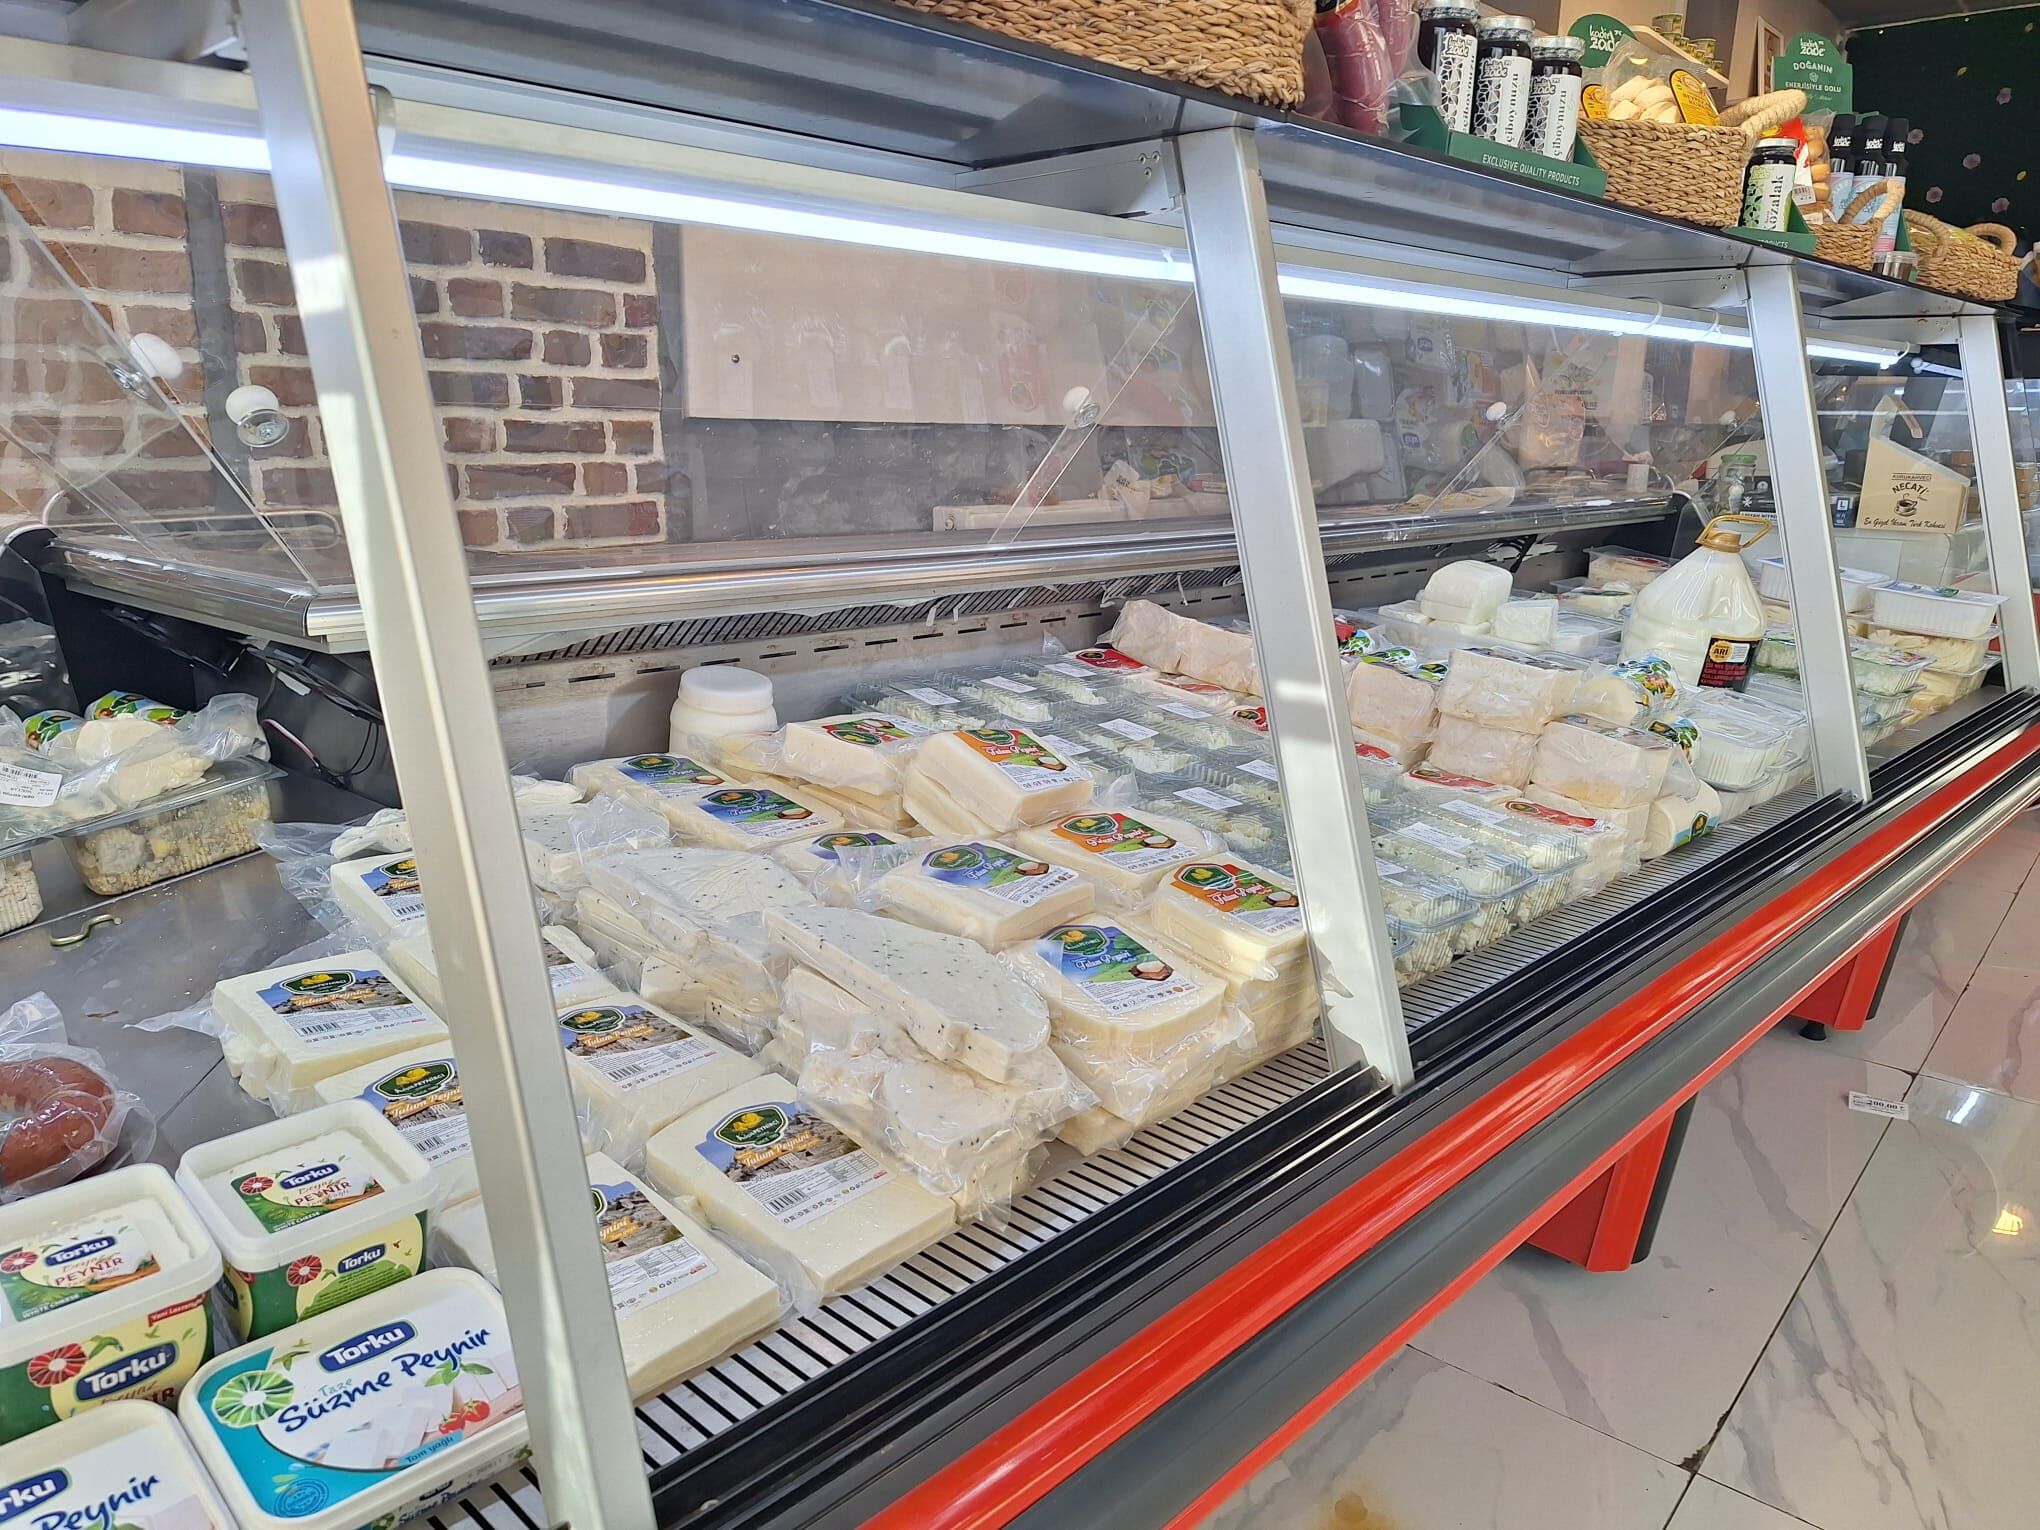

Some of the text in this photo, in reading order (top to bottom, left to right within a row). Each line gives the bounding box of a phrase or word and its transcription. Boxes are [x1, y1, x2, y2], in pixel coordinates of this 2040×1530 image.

[1793, 60, 1833, 74] DOĞANIN
[1505, 73, 1519, 142] çiboynuzu
[1553, 90, 1567, 156] çiboynuzu
[1482, 153, 1580, 187] EXCLUSIVE QUALITY PRODUCTS
[429, 1087, 461, 1103] Peyni
[744, 1150, 774, 1167] Tulum
[776, 1134, 809, 1152] Peyniri
[284, 1166, 334, 1186] Torku
[52, 1239, 108, 1262] Torku
[342, 1248, 382, 1271] Torku
[326, 1327, 405, 1365] Torku
[84, 1352, 166, 1394] Torku
[278, 1327, 491, 1433] Süzme Peynir
[318, 1378, 352, 1398] Taze
[406, 1435, 455, 1464] Tam yağlı
[0, 1479, 56, 1515] rku
[31, 1473, 159, 1530] Peynir
